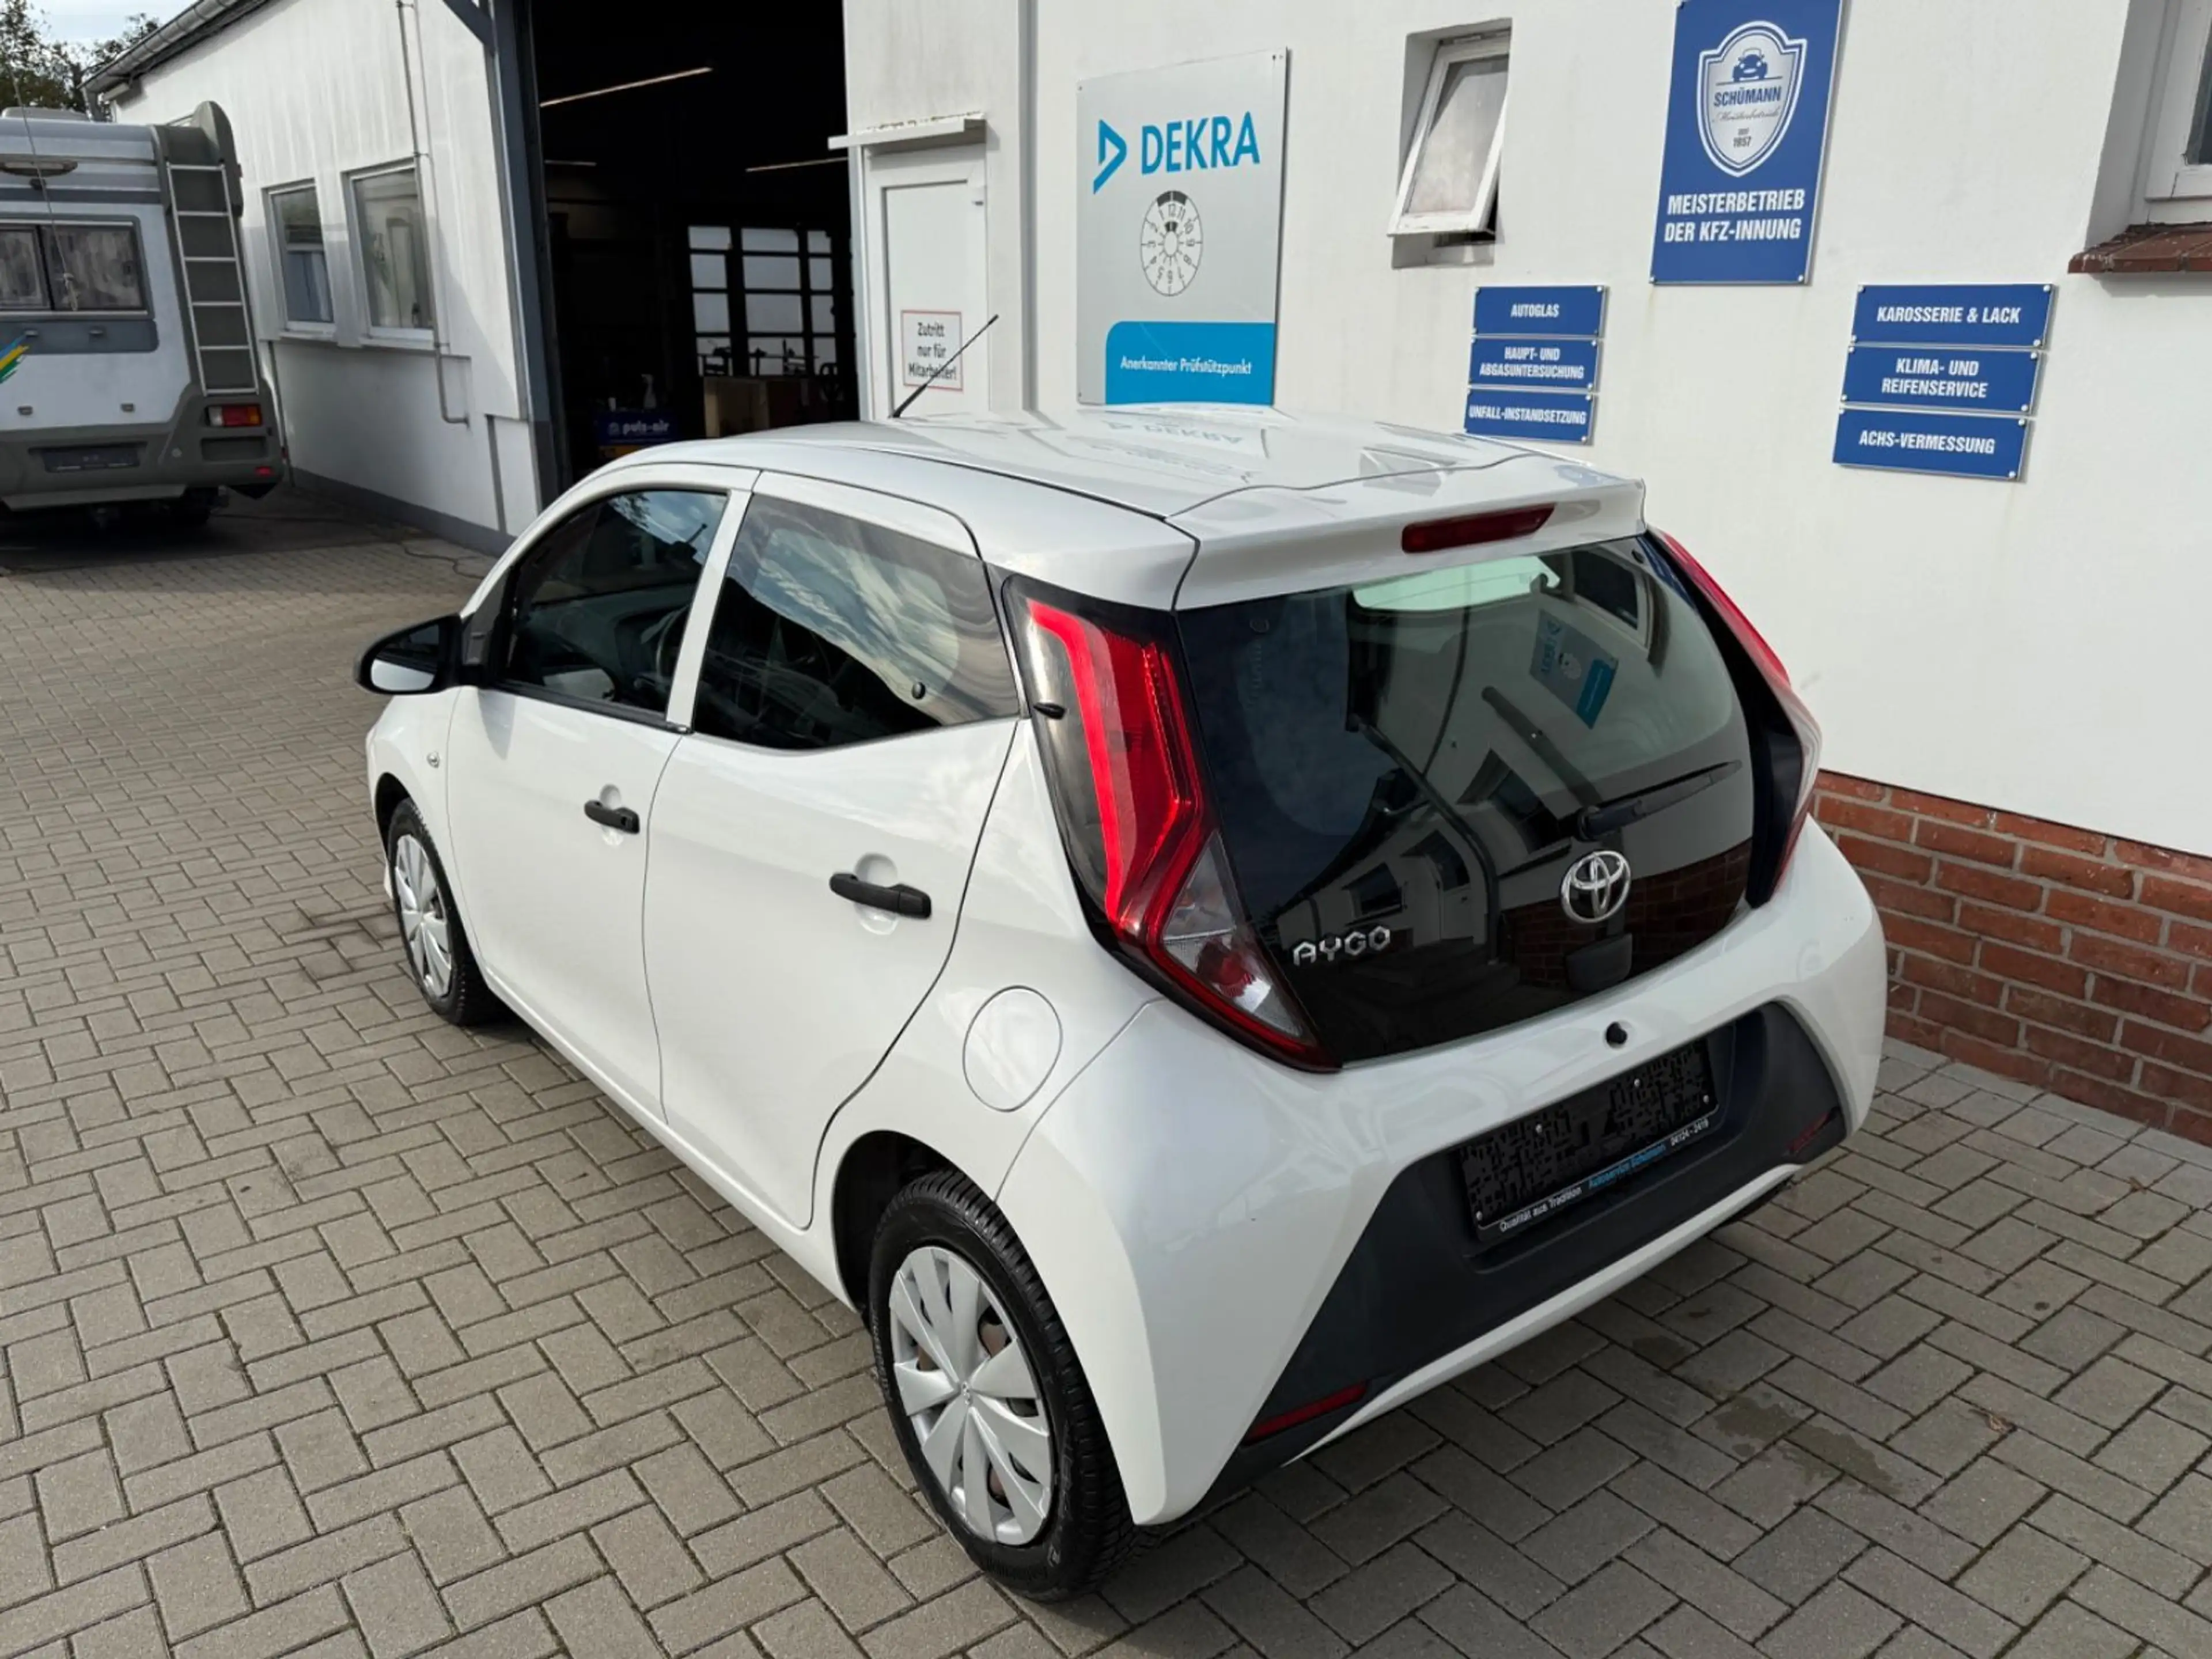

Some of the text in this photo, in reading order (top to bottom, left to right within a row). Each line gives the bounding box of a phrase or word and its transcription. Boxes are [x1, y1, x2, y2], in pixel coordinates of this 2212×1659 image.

[1714, 86, 1781, 107] SCHÜMANN
[1141, 111, 1261, 175] DEKRA
[1667, 188, 1805, 215] MEISTERBETRIEB
[1664, 218, 1802, 242] DER KFZ-INNUNG
[1510, 303, 1559, 317] AUTOGLAS
[1877, 306, 2021, 324] KAROSSERIE & LACK
[1120, 355, 1178, 372] Anerkannter
[1504, 346, 1560, 362] HAUPT- UND
[1895, 358, 1979, 376] KLIMA- UND
[1881, 377, 1988, 399] REIFENSERVICE
[1858, 430, 1995, 454] ACHS-VERMESSUNG
[1293, 925, 1391, 966] AYGO
